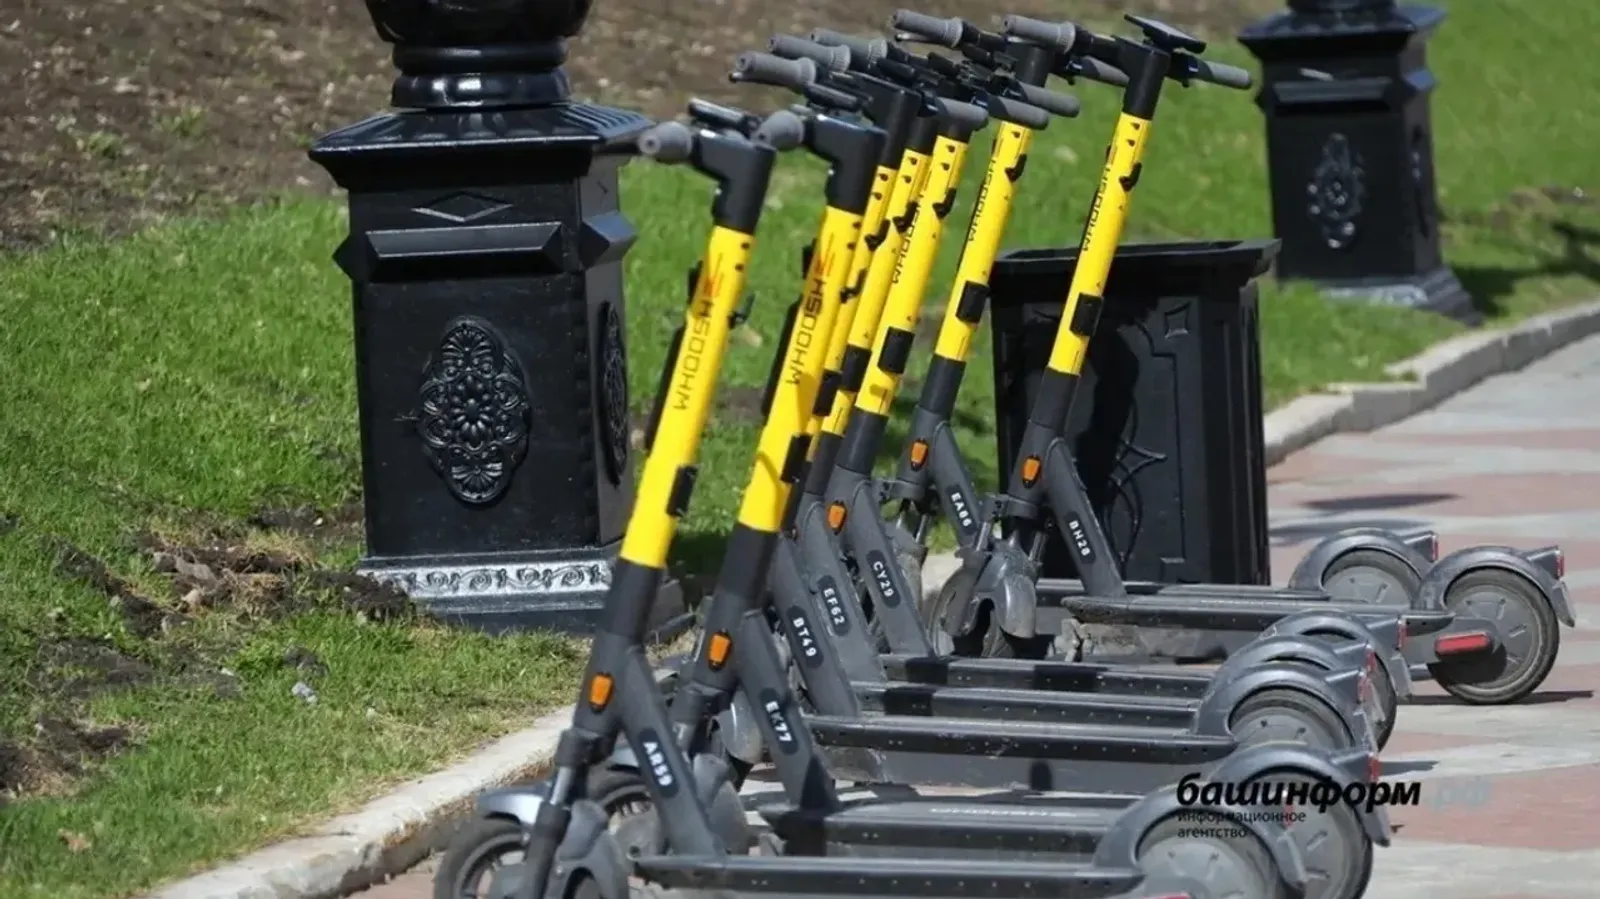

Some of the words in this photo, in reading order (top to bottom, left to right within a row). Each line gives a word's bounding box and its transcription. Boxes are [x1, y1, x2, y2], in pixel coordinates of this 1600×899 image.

[785, 276, 827, 386] WHOOSH
[673, 300, 715, 411] WHOOSH
[1068, 519, 1092, 557] BH28
[872, 560, 894, 598] CY29
[823, 587, 846, 626] EF62
[792, 616, 817, 658] BT49
